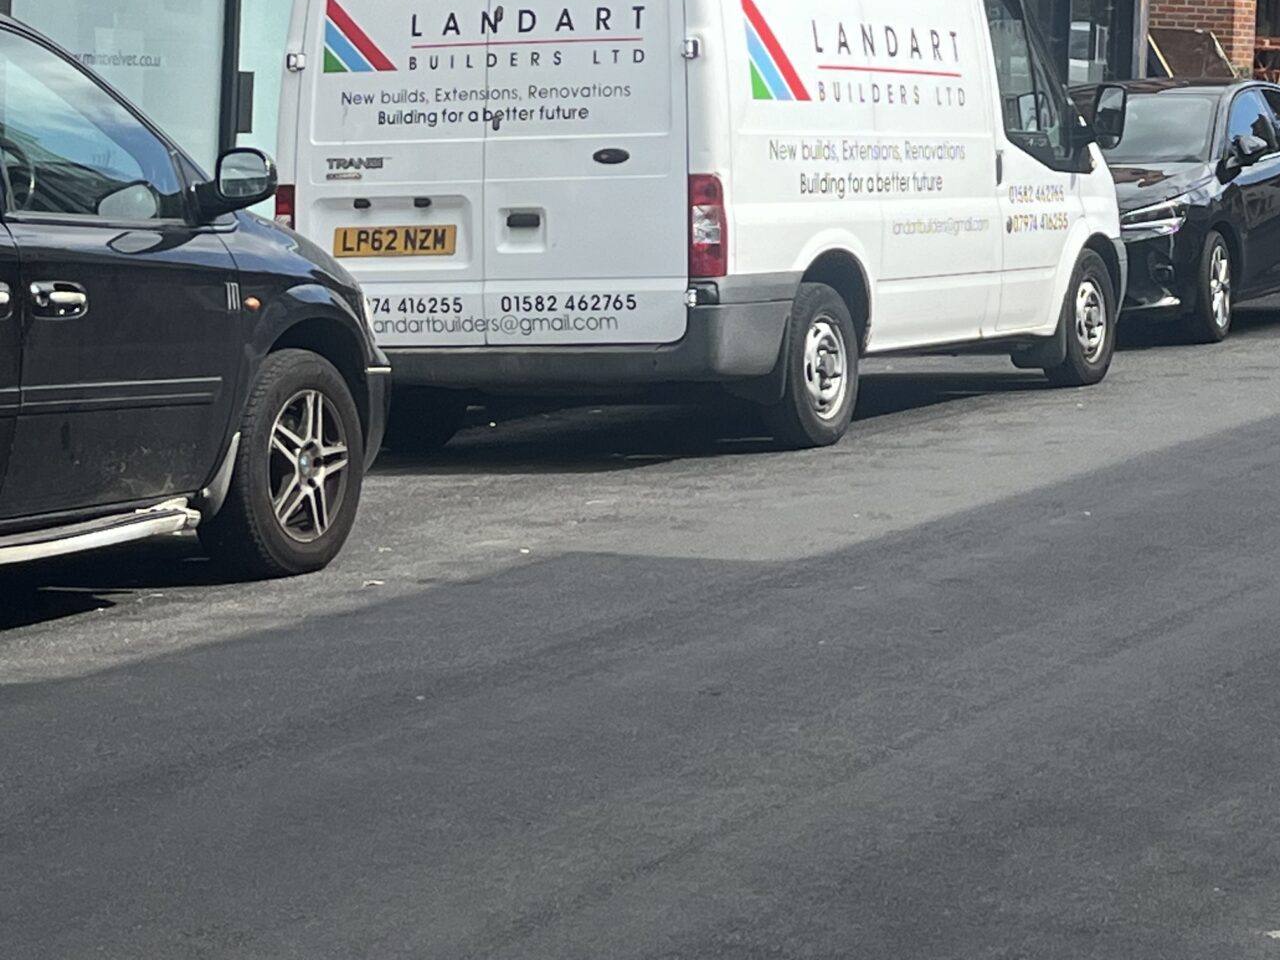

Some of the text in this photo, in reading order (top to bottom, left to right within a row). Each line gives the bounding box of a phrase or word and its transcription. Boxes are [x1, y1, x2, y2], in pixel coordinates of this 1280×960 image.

[411, 5, 645, 37] LANDART
[811, 19, 960, 62] LANDART
[409, 49, 645, 70] BUILDERS LTD
[341, 84, 632, 107] New builds, Extensions, Renovations
[818, 81, 966, 107] BUILDERS LTD
[378, 106, 590, 128] Building for a better future
[769, 139, 966, 163] New builds, Extensions, Renovations
[800, 172, 944, 199] Building for a better future
[342, 228, 447, 252] LP62 NZM
[366, 294, 638, 314] 74 416255 01582 462765
[373, 313, 619, 336] andartbuilders@gmail.com
